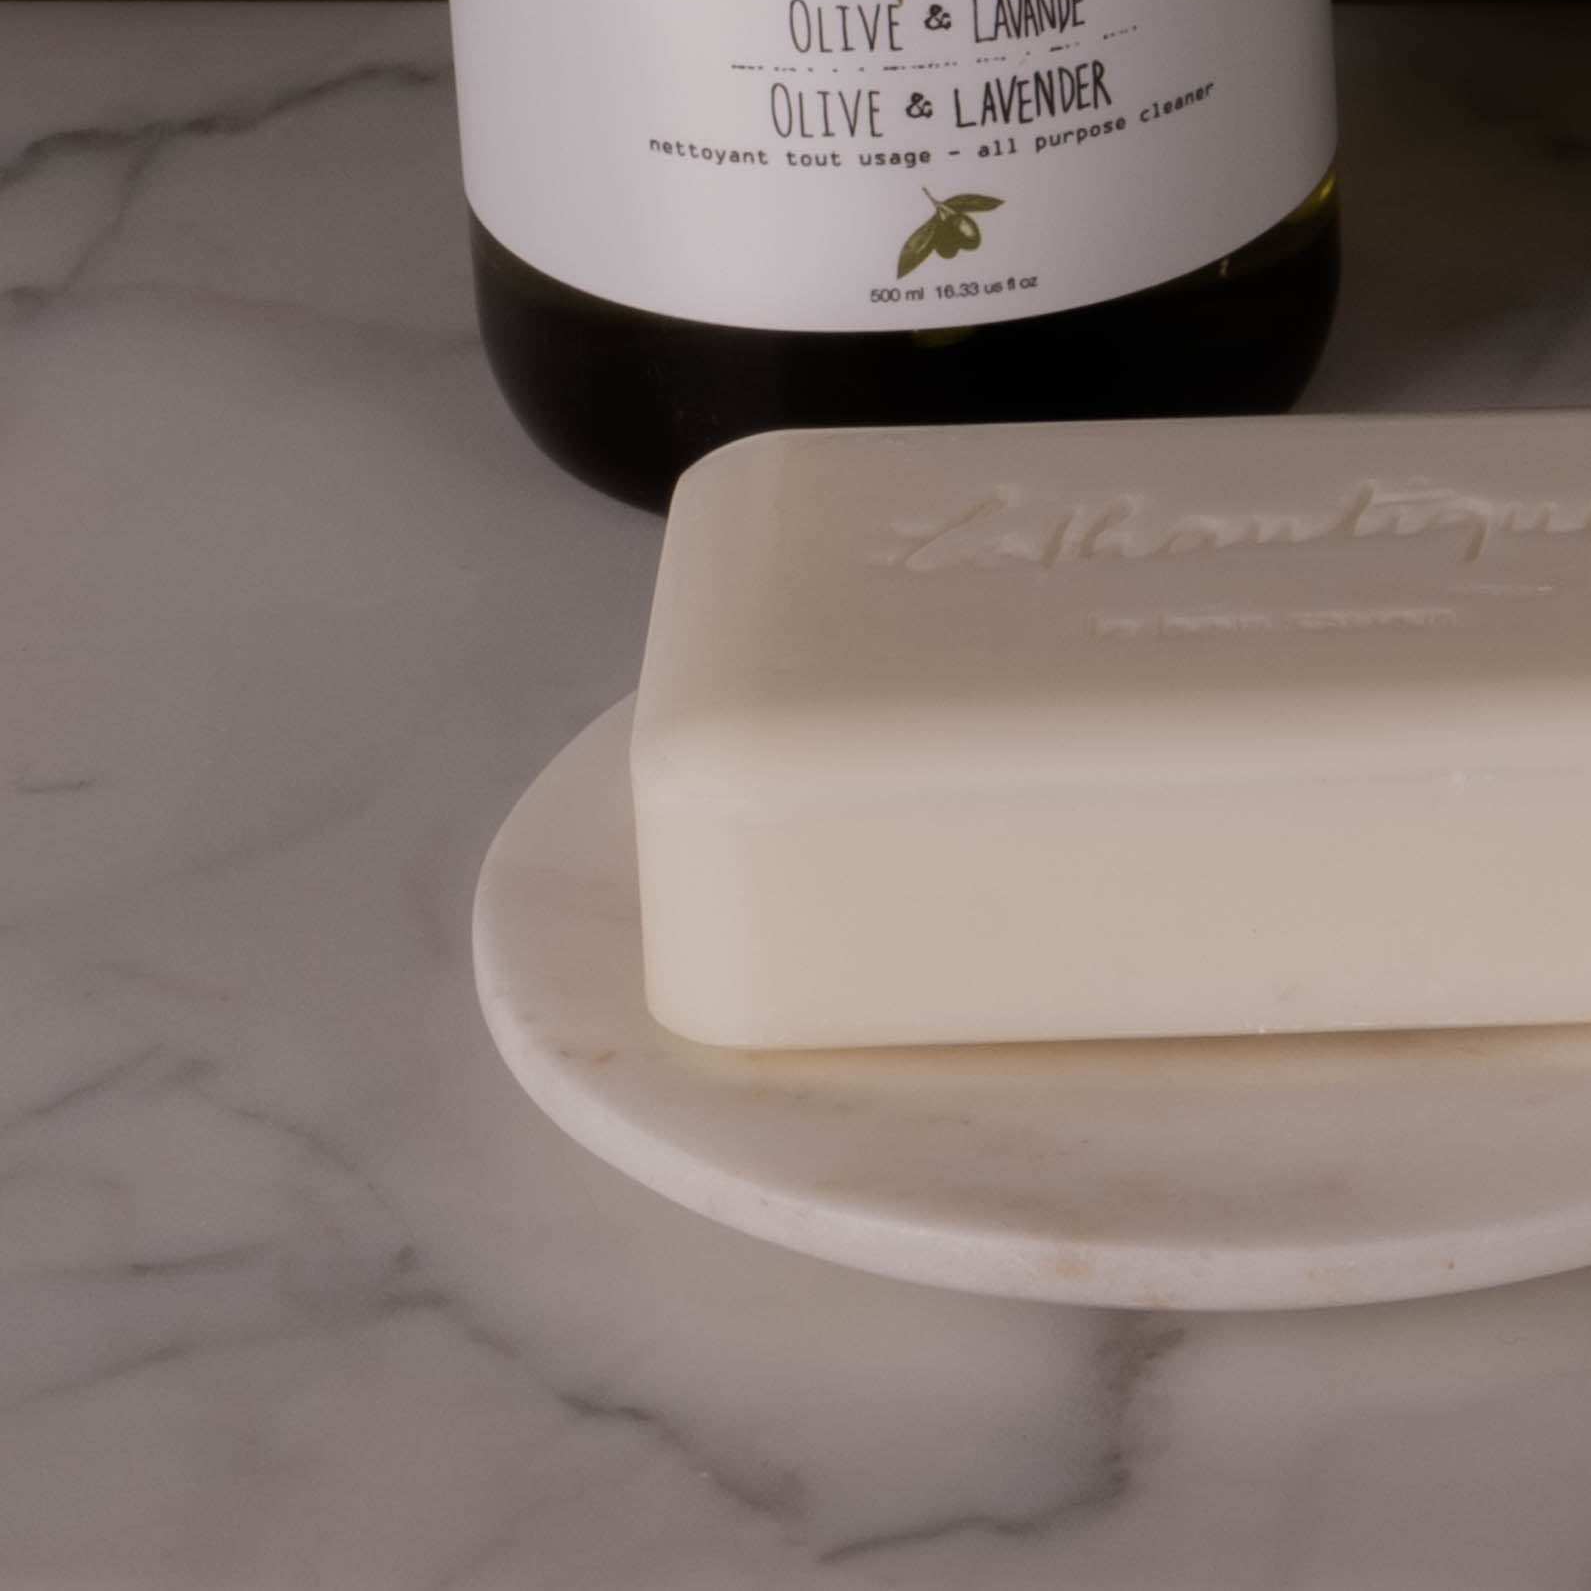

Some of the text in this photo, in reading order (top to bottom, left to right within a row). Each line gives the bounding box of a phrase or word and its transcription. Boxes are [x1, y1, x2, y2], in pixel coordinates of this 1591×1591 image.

[924, 4, 952, 30] &
[649, 138, 769, 166] nettoyant
[787, 151, 842, 167] tout
[859, 150, 931, 168] usage
[978, 138, 1017, 158] all
[1035, 116, 1126, 153] purpose
[1139, 82, 1214, 122] cleaner
[771, 59, 1113, 139] OLIVE & LAVENDER
[870, 276, 1038, 302] 500 ml 16.33 us fl oz
